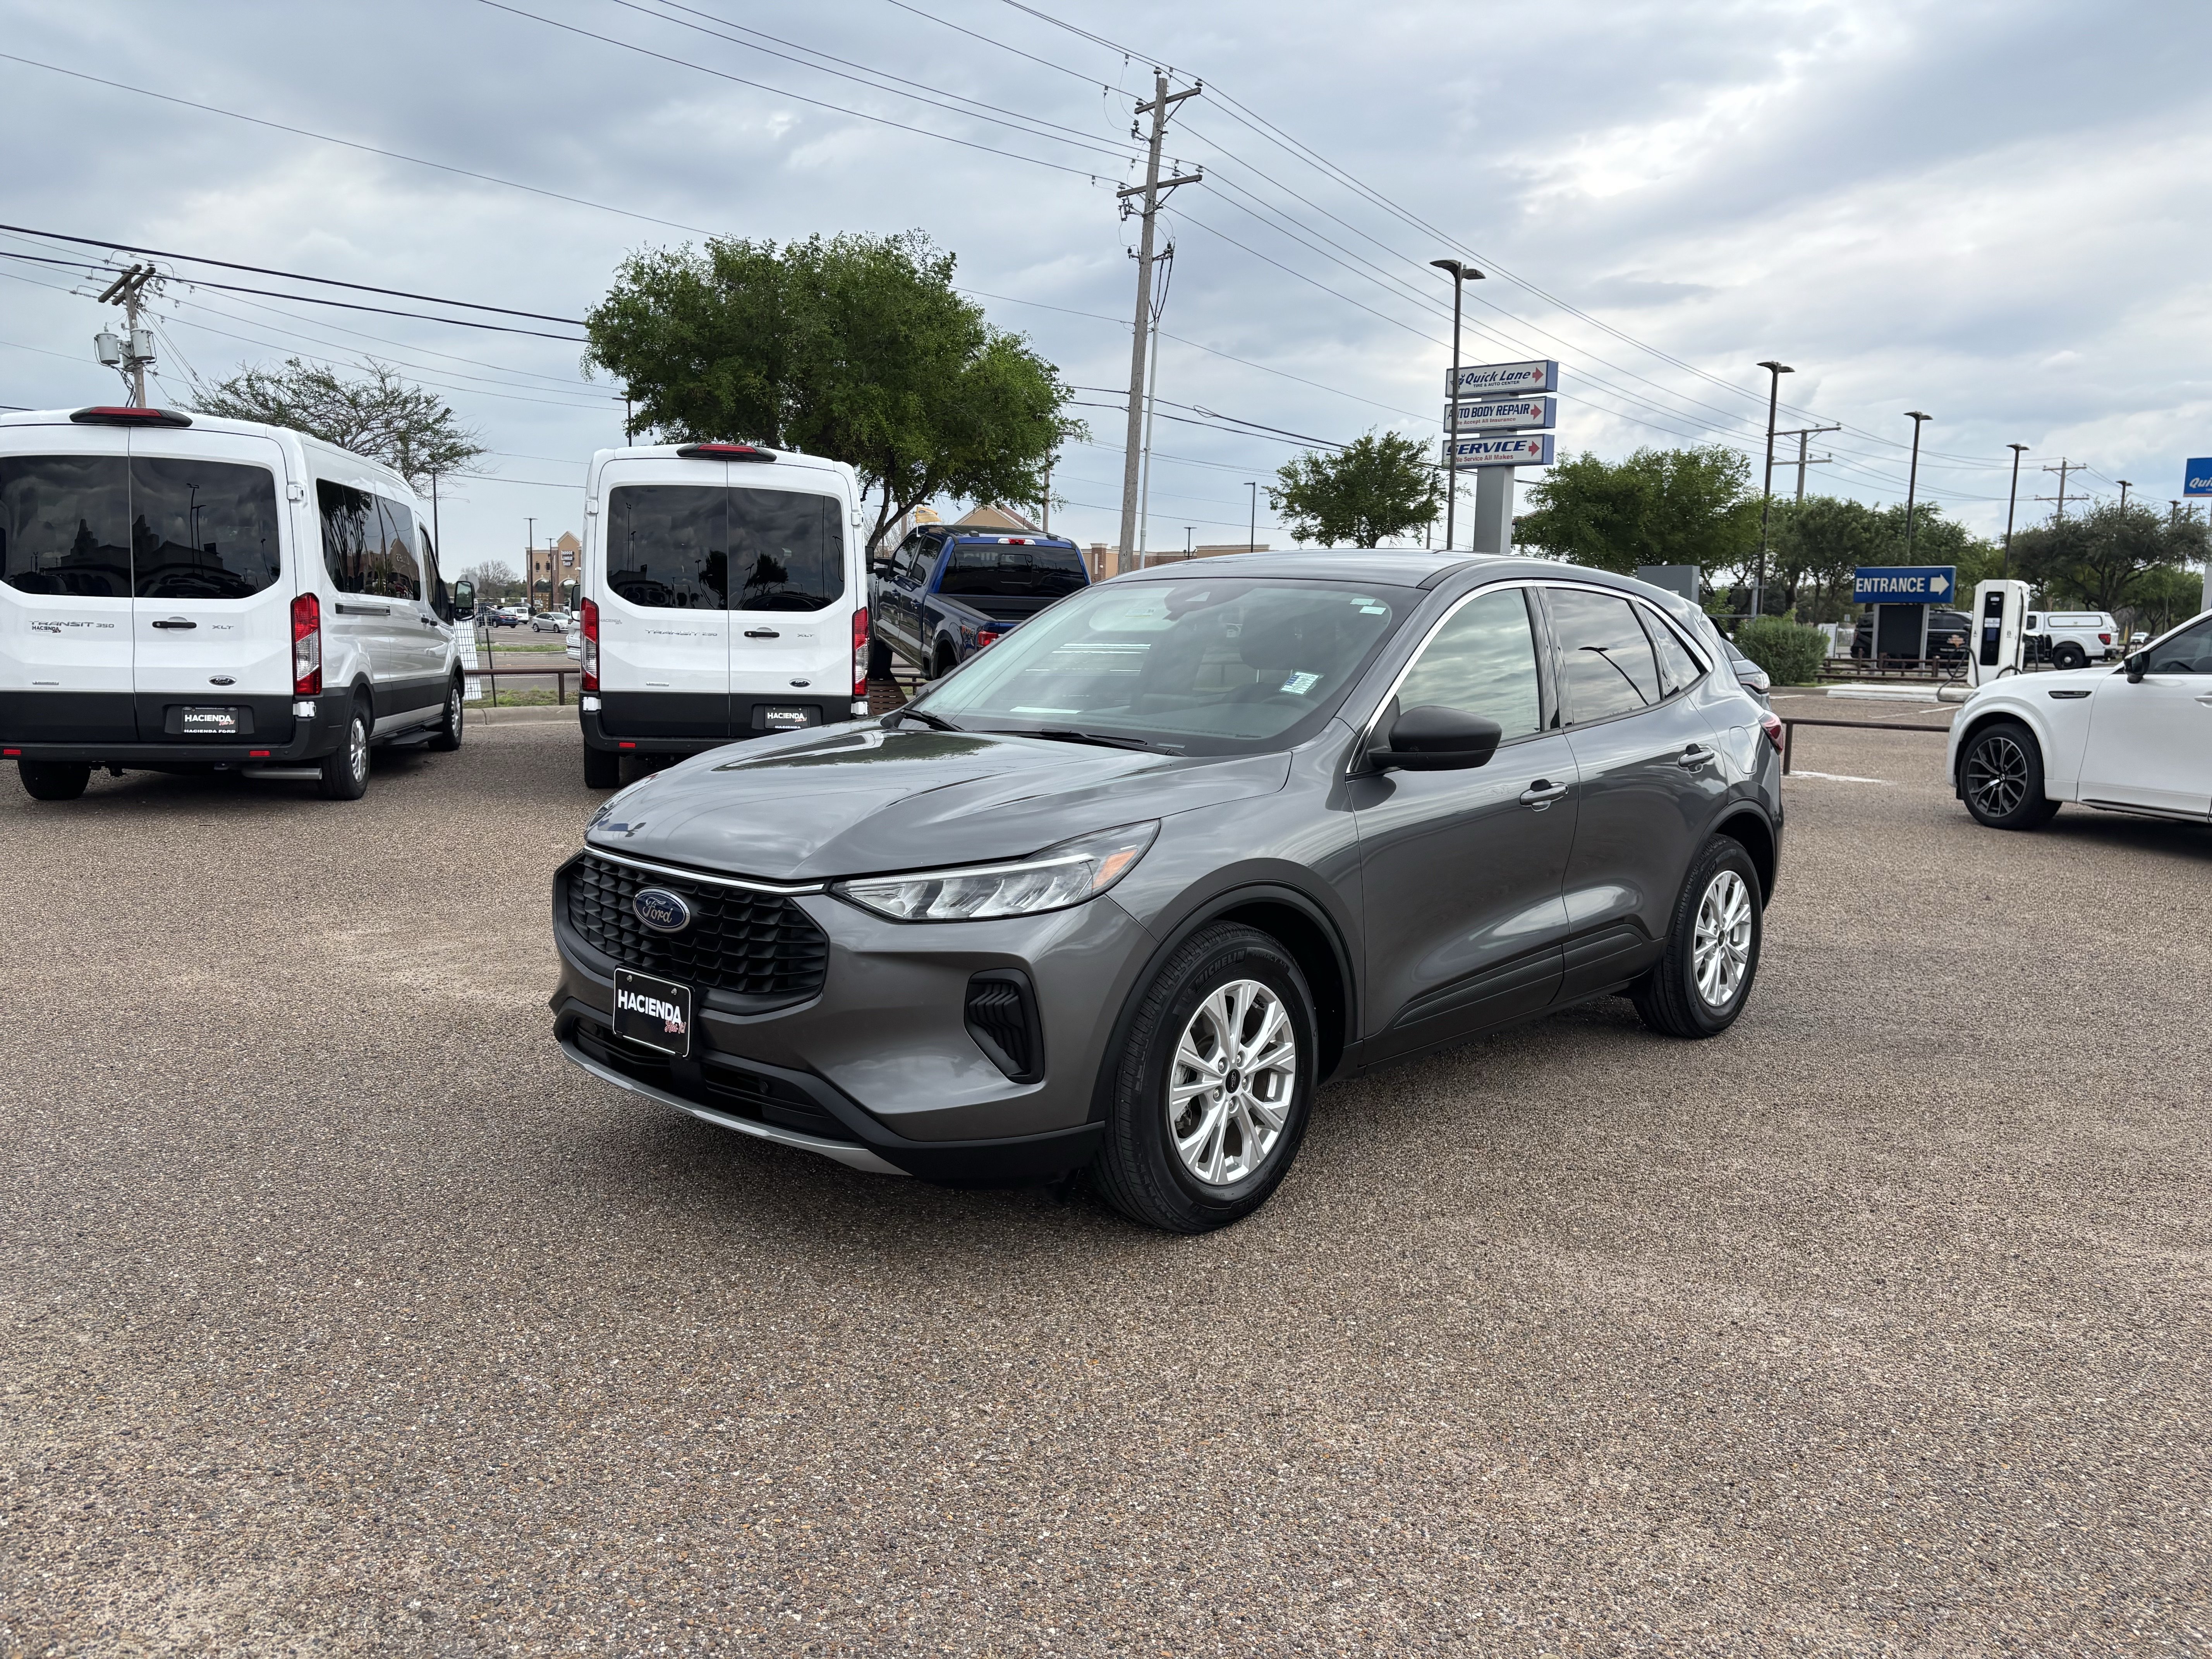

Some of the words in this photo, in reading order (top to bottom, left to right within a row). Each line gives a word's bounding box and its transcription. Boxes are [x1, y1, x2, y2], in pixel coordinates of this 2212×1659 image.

[1465, 371, 1498, 385] Quick
[1499, 370, 1531, 381] Lane
[1471, 406, 1495, 417] BODY
[1496, 404, 1530, 416] REPAIR
[1855, 577, 1925, 592] ENTRANCE
[642, 896, 673, 923] Ford
[1252, 951, 1278, 963] PRIMACY
[1195, 951, 1245, 988] MICHELIN
[618, 989, 682, 1027] HACIENDA
[665, 1020, 678, 1033] Has
